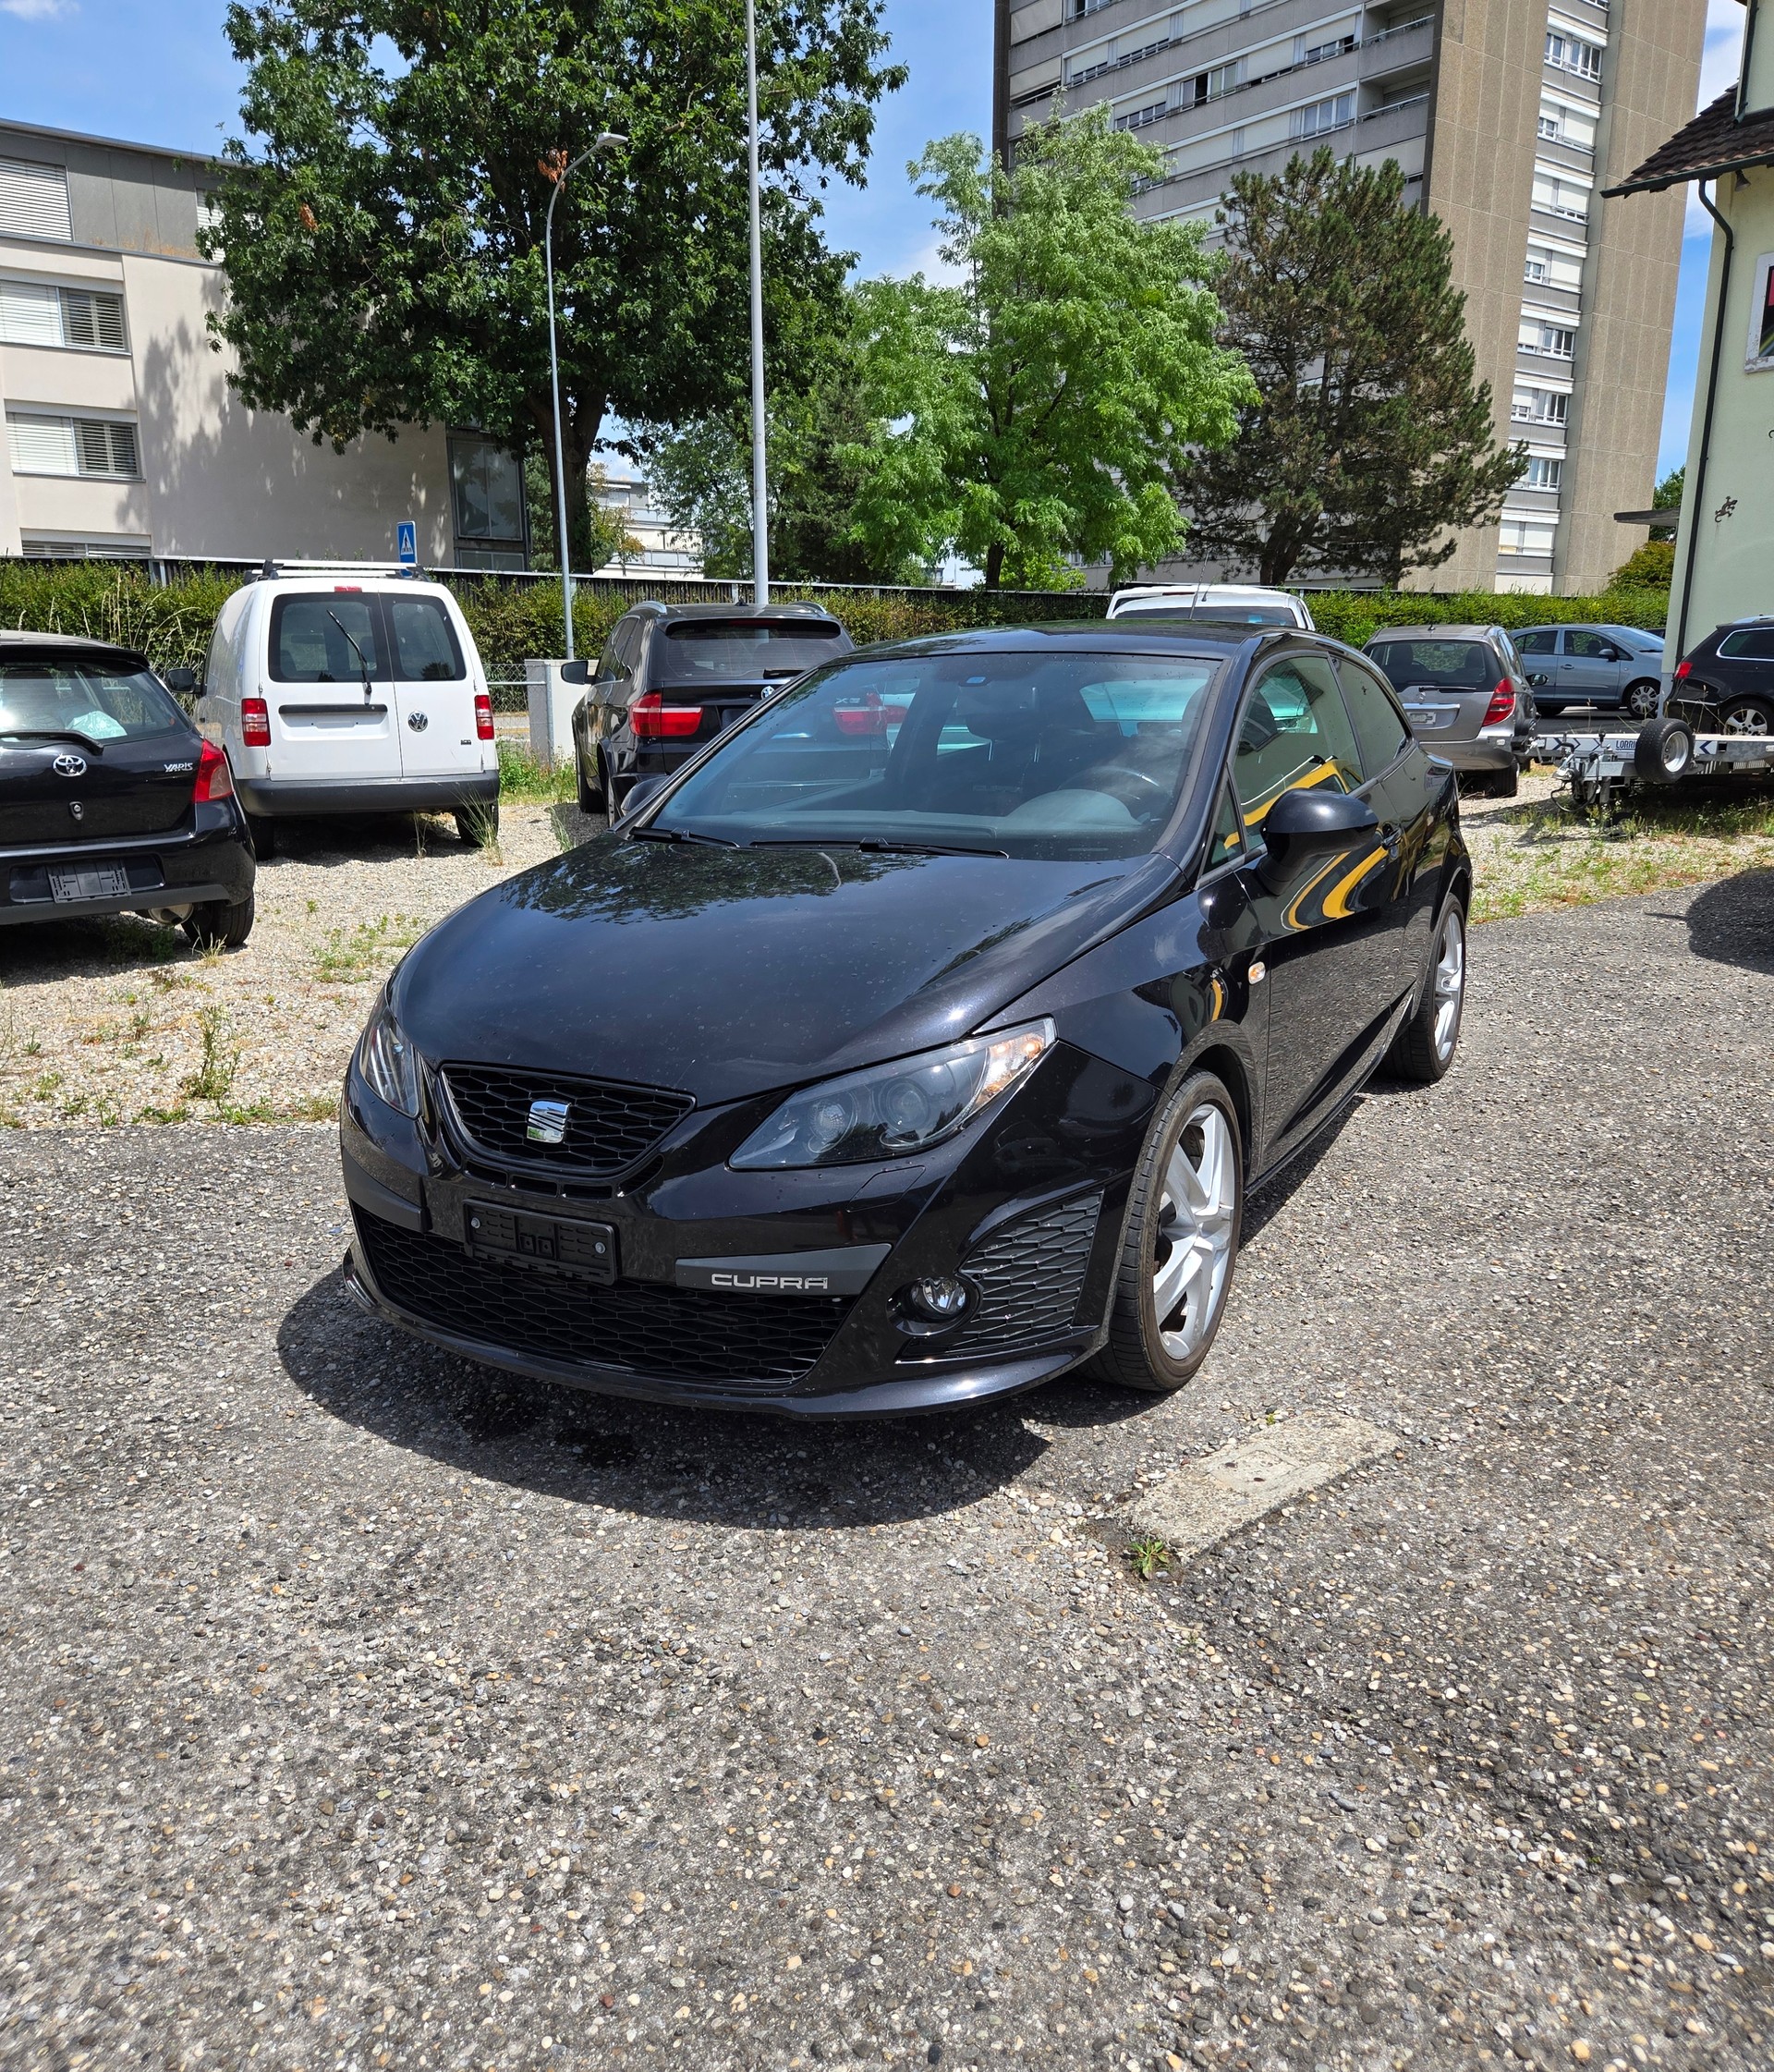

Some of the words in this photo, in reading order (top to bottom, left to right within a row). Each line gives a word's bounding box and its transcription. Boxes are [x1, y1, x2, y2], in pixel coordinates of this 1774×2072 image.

[1615, 740, 1635, 749] LORRI
[164, 762, 193, 773] YARIS
[711, 1273, 828, 1289] CUPRA
